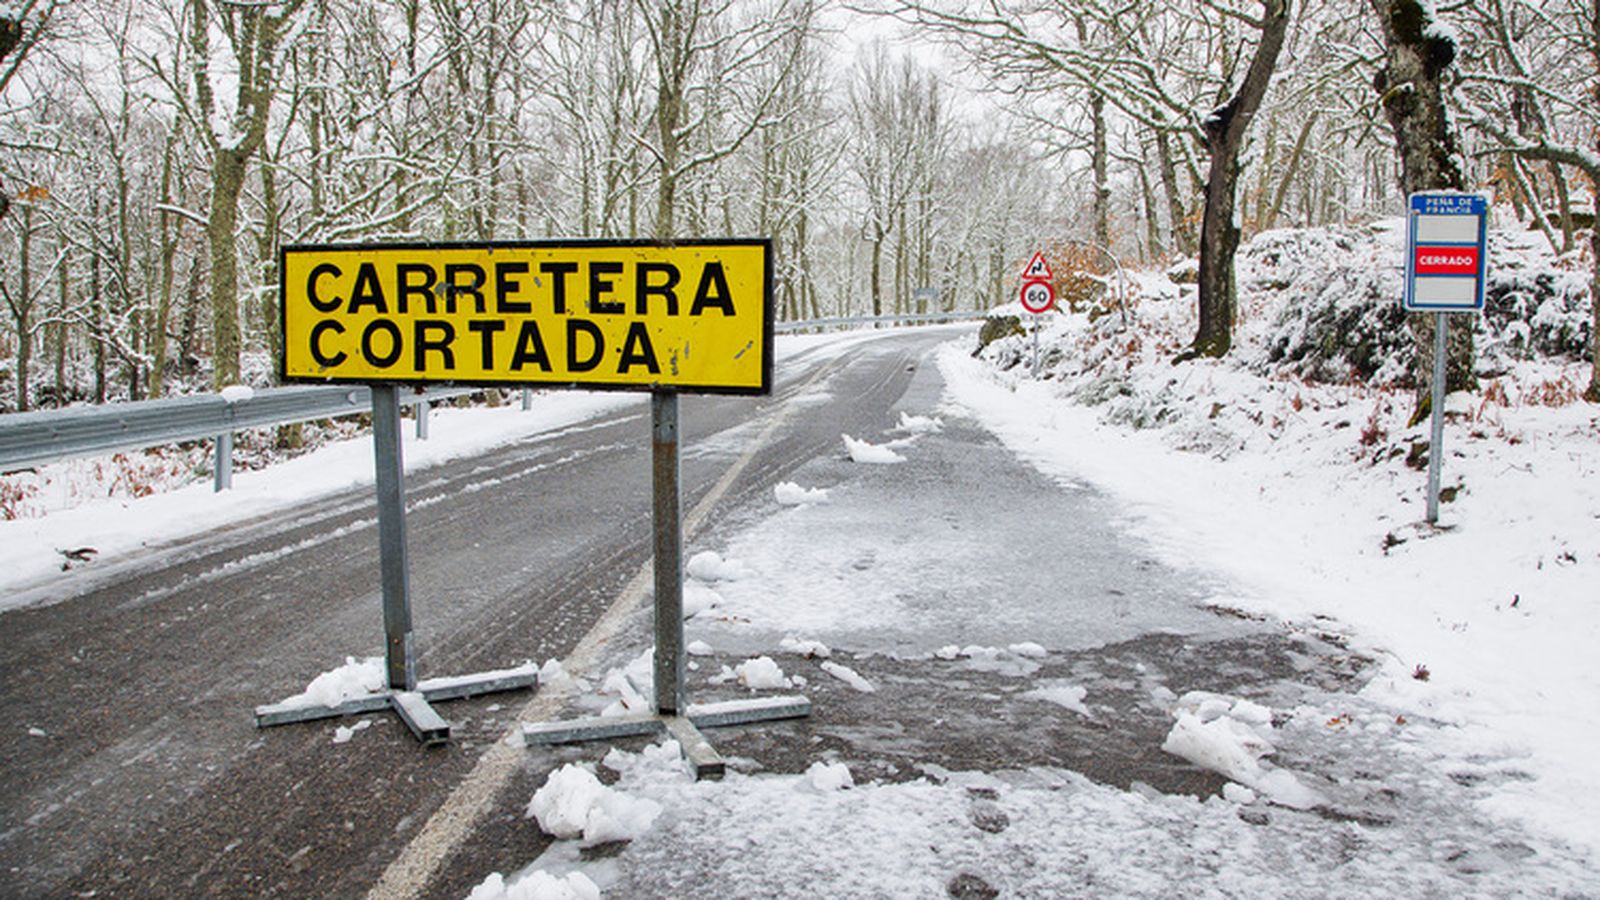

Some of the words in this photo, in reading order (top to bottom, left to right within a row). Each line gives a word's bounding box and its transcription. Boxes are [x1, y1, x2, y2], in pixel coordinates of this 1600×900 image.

[1459, 198, 1472, 206] DE
[1419, 255, 1473, 265] CERRADO
[306, 261, 737, 317] CARRETERA
[1027, 290, 1047, 302] 60
[309, 318, 661, 374] CORTADA
